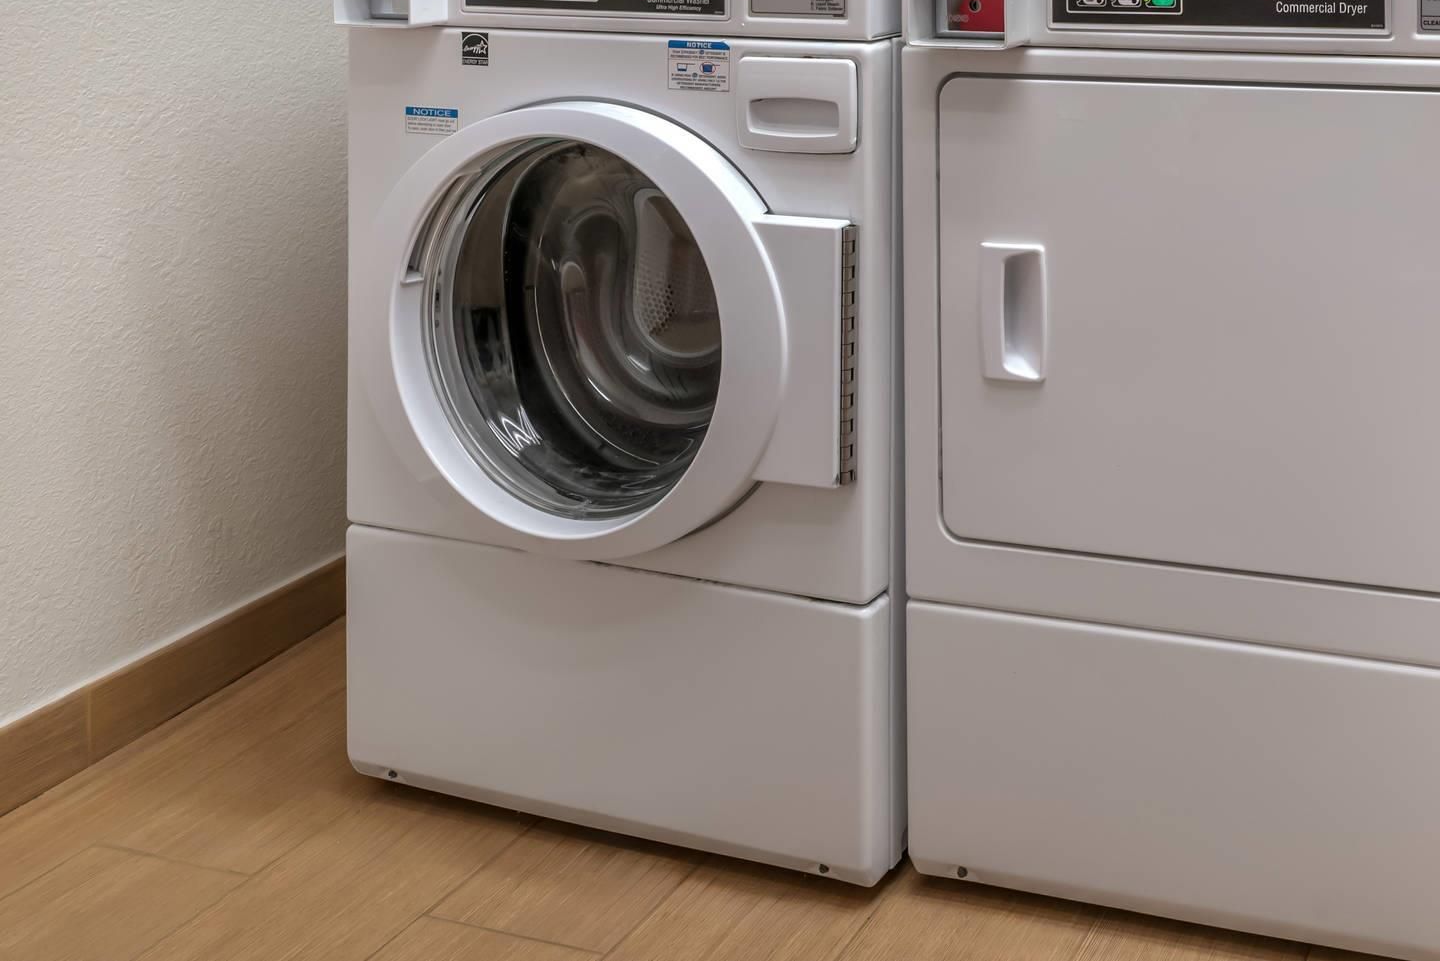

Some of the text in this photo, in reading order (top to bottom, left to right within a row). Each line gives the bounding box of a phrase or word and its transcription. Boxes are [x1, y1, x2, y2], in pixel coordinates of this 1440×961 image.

[1275, 1, 1368, 17] Commercial Dryer
[413, 108, 452, 117] NOTICE
